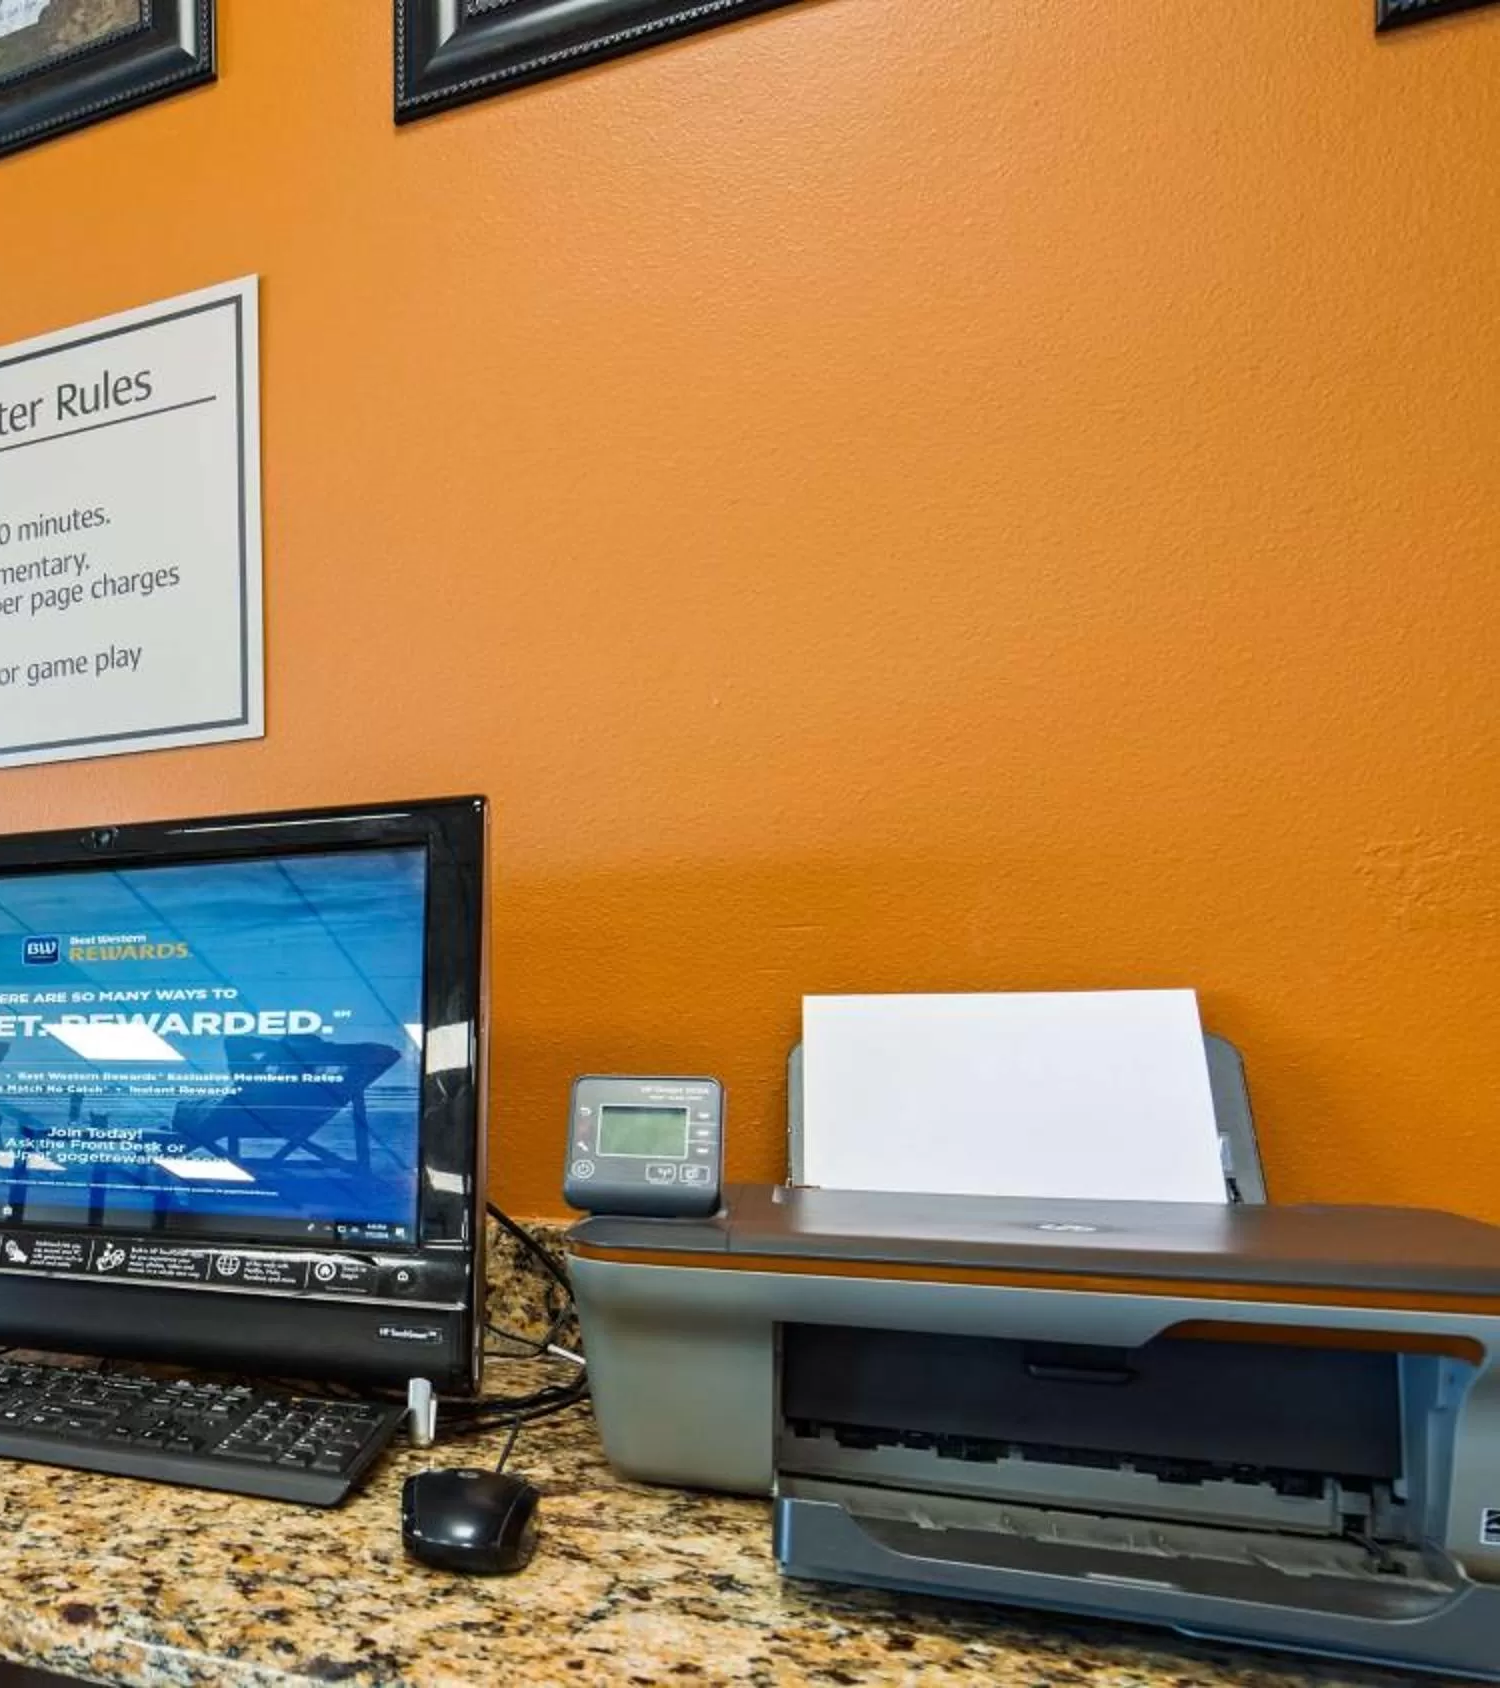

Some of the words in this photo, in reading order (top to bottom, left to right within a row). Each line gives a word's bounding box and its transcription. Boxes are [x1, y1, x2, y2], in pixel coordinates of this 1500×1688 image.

[56, 369, 153, 421] Rules
[17, 506, 112, 542] minutes.
[31, 583, 84, 617] page
[91, 565, 181, 599] charges
[27, 655, 88, 687] game
[95, 643, 143, 678] play
[27, 941, 57, 955] BW
[69, 936, 96, 945] Best
[97, 934, 147, 944] Western
[33, 992, 68, 1004] ARE
[72, 991, 95, 1003] SO
[99, 990, 153, 1002] MANY
[155, 989, 208, 1001] WAYS
[212, 987, 239, 999] TO
[17, 1071, 45, 1080] Best
[47, 1071, 100, 1080] Western
[233, 1072, 298, 1082] Members
[302, 1073, 344, 1082] Rates
[7, 1084, 43, 1093] Match
[129, 1086, 175, 1094] Instant
[47, 1127, 82, 1139] Join
[86, 1128, 143, 1141] Today!
[5, 1137, 35, 1148] Ask
[40, 1137, 65, 1149] the
[70, 1139, 114, 1151] Front
[119, 1140, 163, 1153] Desk
[167, 1142, 186, 1153] or
